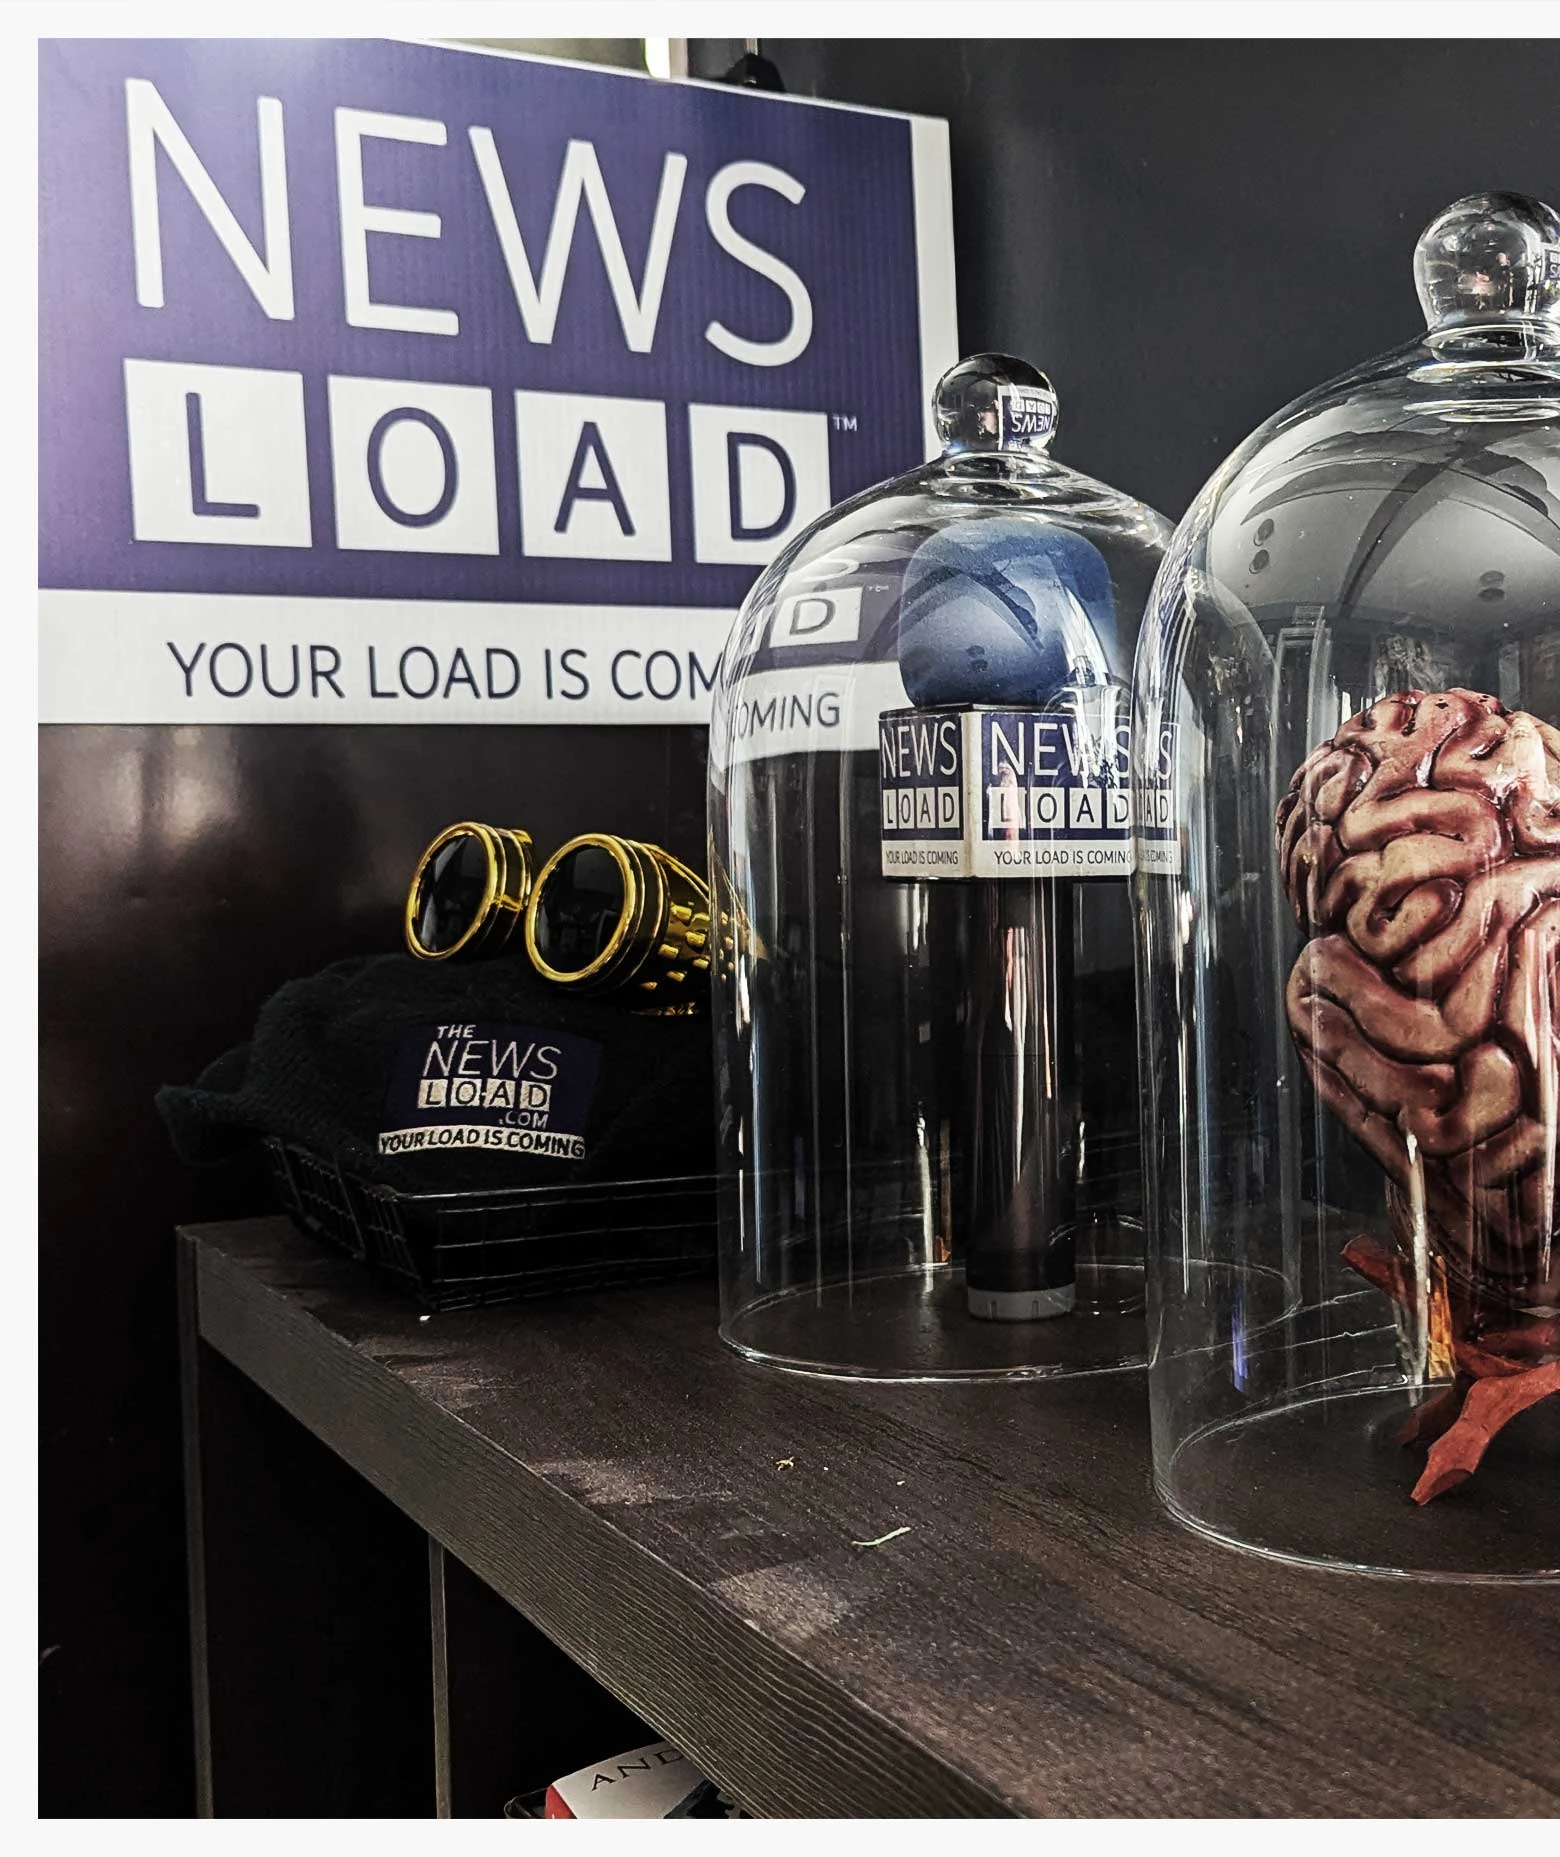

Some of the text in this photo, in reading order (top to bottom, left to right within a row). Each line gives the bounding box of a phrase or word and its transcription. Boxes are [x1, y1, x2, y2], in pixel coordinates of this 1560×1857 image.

[125, 77, 814, 367] NEWS
[185, 391, 798, 543] LOAD
[167, 642, 345, 699] YOUR
[368, 645, 521, 699] LOAD
[545, 648, 590, 699] IS
[881, 721, 957, 779] NEWS
[886, 794, 956, 822] LOAD
[999, 793, 1130, 823] LOAD
[885, 850, 959, 865] YOUR LOAD IS COMING
[994, 850, 1031, 865] YOUR
[1035, 850, 1069, 865] LOAD
[1073, 850, 1084, 865] IS
[437, 1024, 477, 1039] THE
[422, 1039, 562, 1080] NEWS
[424, 1081, 549, 1108] LOAD
[380, 1129, 585, 1158] YOUR LOAD IS COMING
